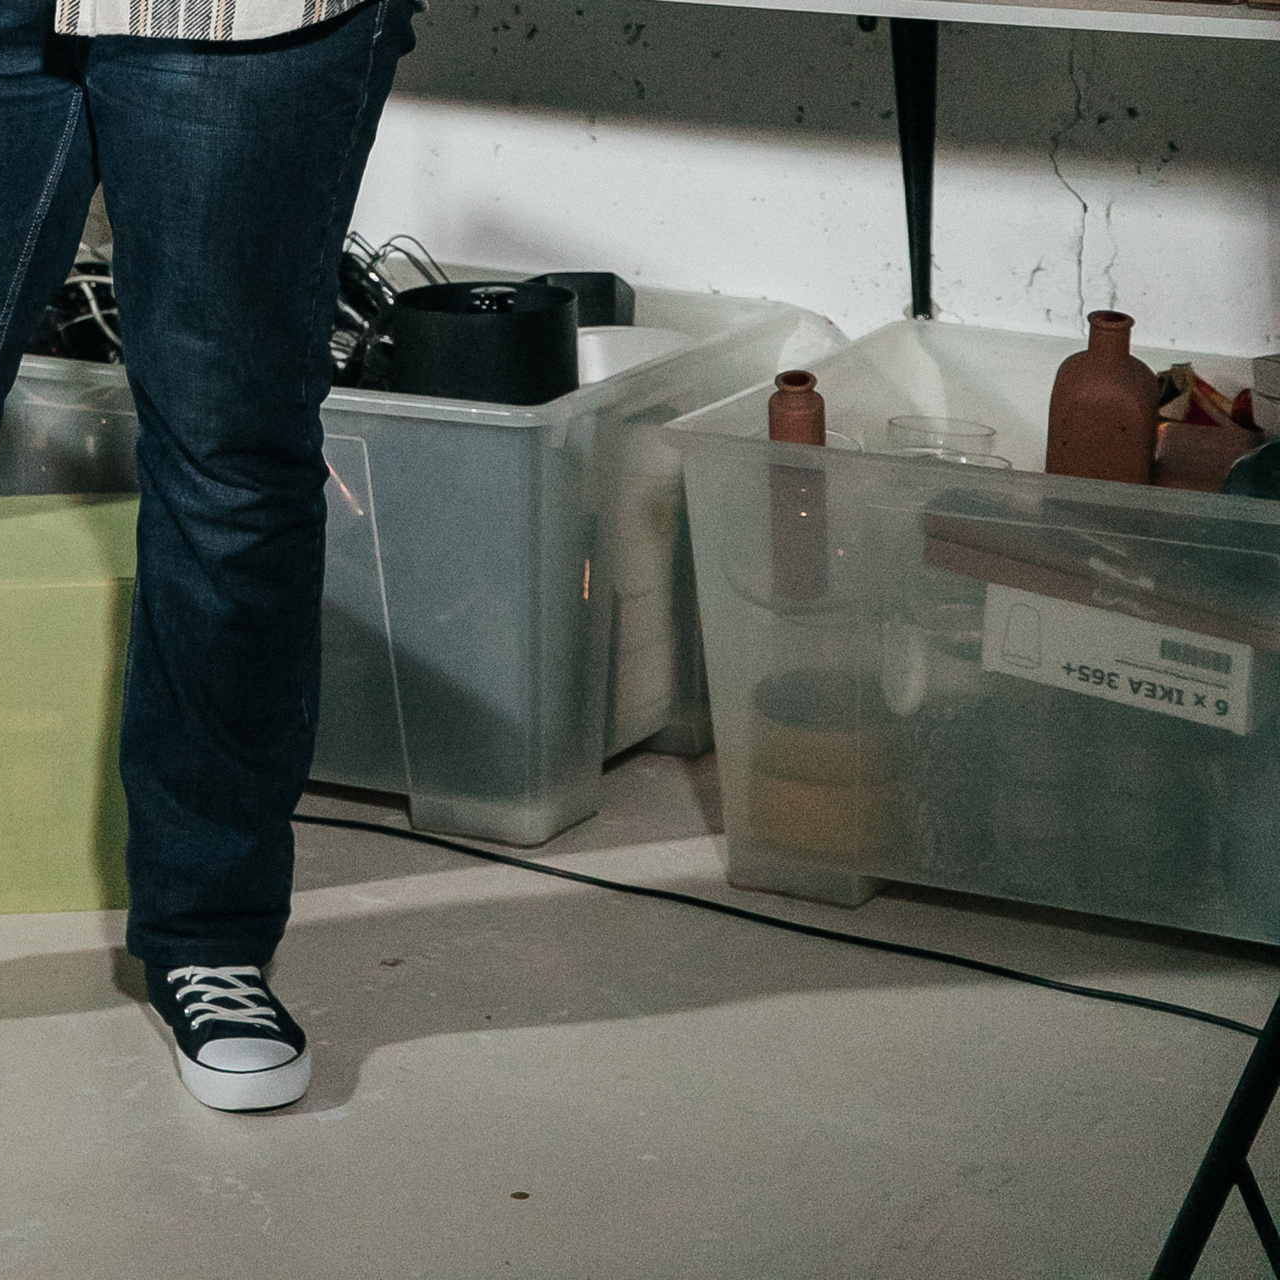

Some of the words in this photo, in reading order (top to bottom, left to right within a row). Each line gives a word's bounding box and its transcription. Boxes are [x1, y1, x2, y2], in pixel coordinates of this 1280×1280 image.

[1061, 660, 1121, 690] 365+
[1127, 676, 1185, 707] IKEA
[1214, 698, 1230, 717] 6
